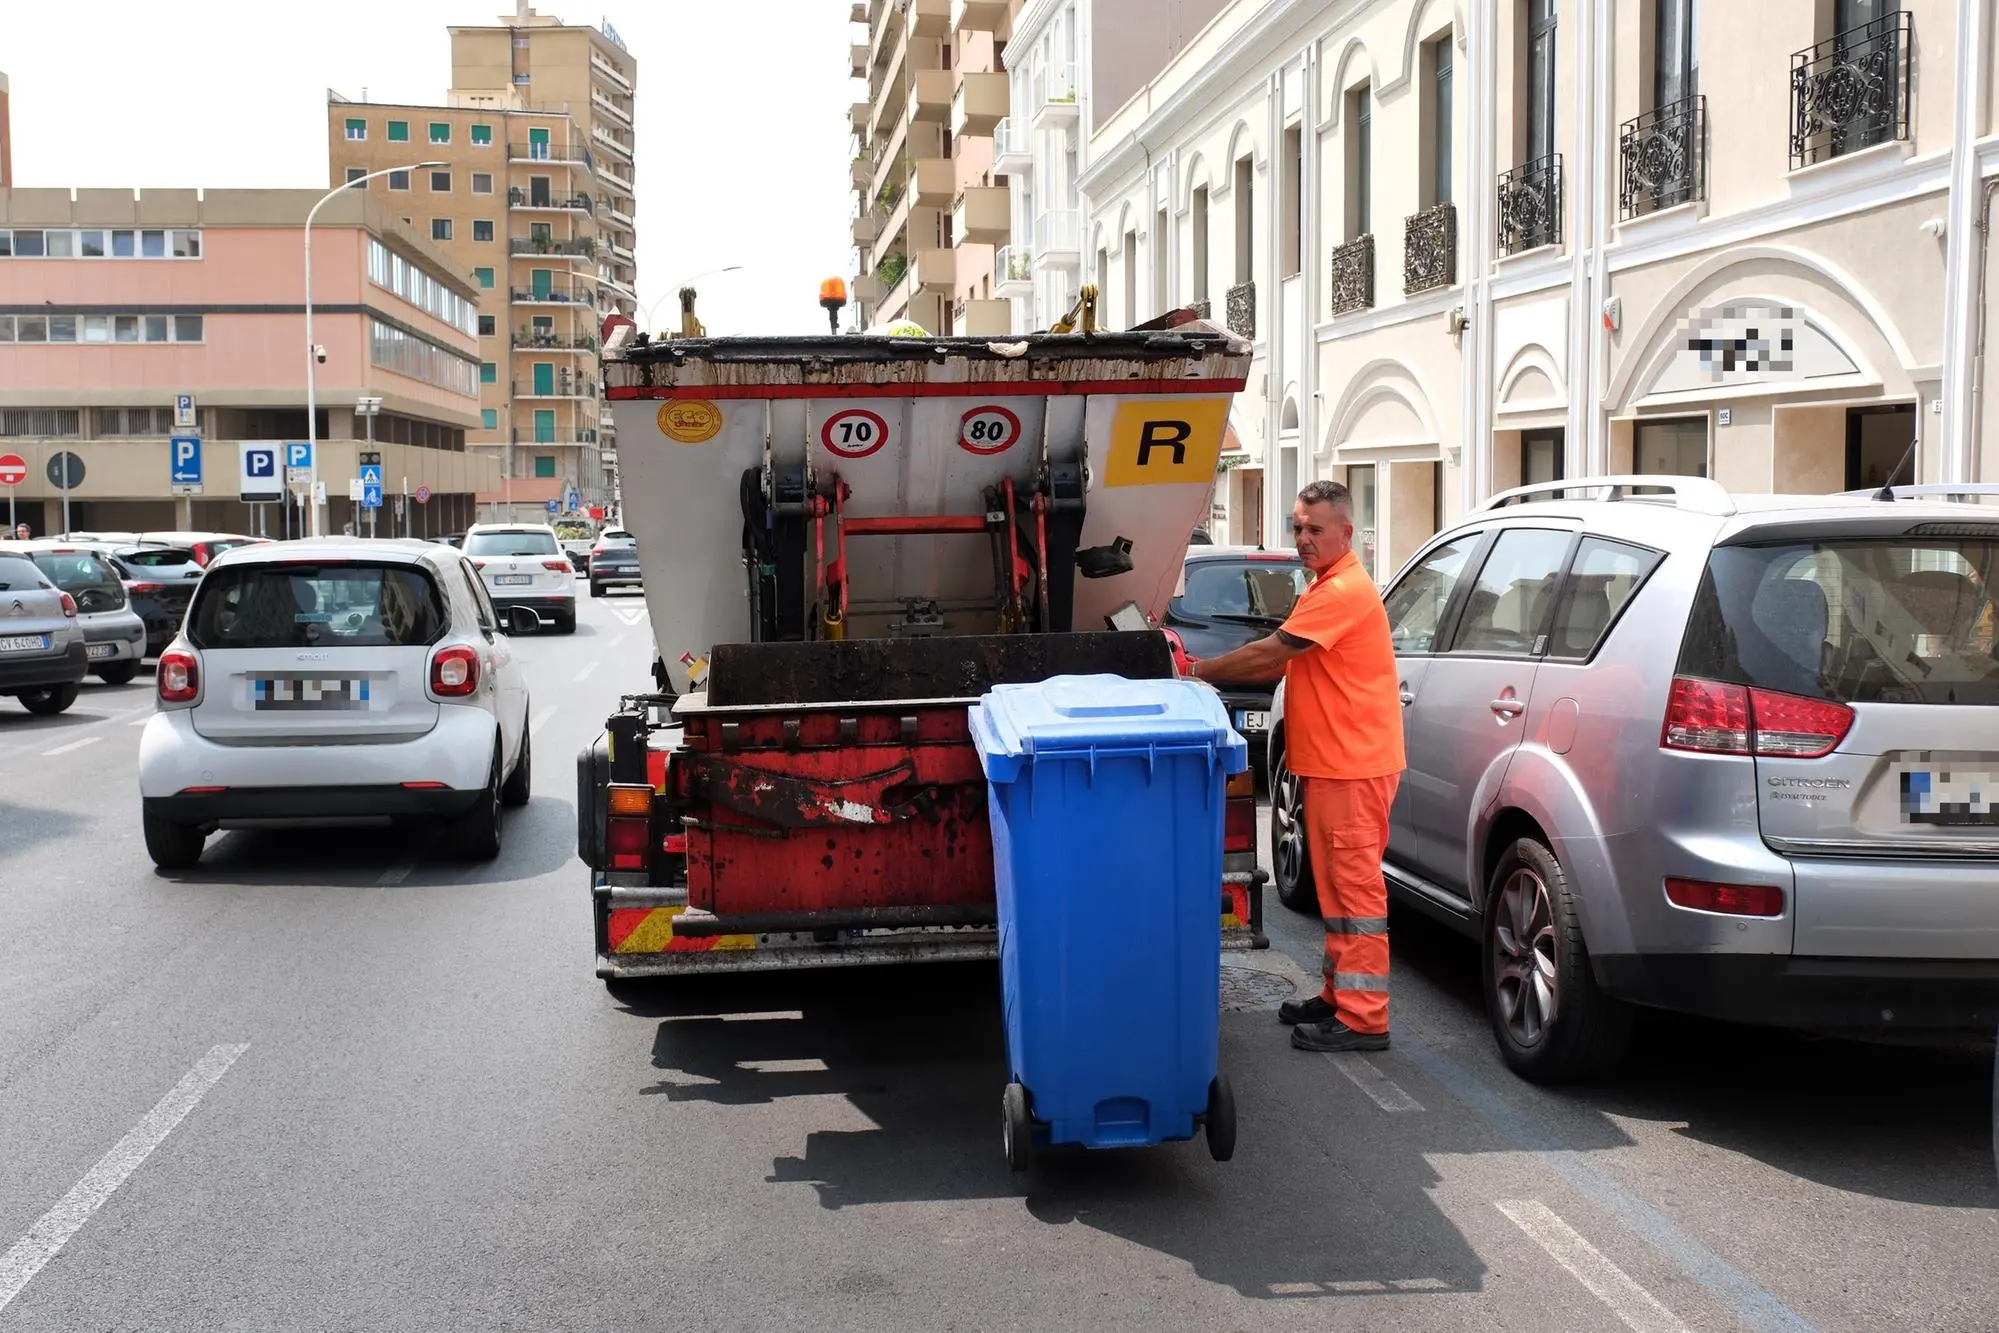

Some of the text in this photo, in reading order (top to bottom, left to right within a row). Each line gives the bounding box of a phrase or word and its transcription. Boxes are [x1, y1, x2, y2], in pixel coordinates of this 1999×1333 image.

[180, 397, 188, 407] P
[840, 422, 872, 443] 70
[971, 420, 1004, 441] 80
[1137, 420, 1191, 465] R
[177, 442, 194, 467] P
[253, 454, 269, 474] P
[291, 446, 307, 465] P
[1247, 712, 1264, 728] EJ
[1767, 776, 1850, 789] CITROËN
